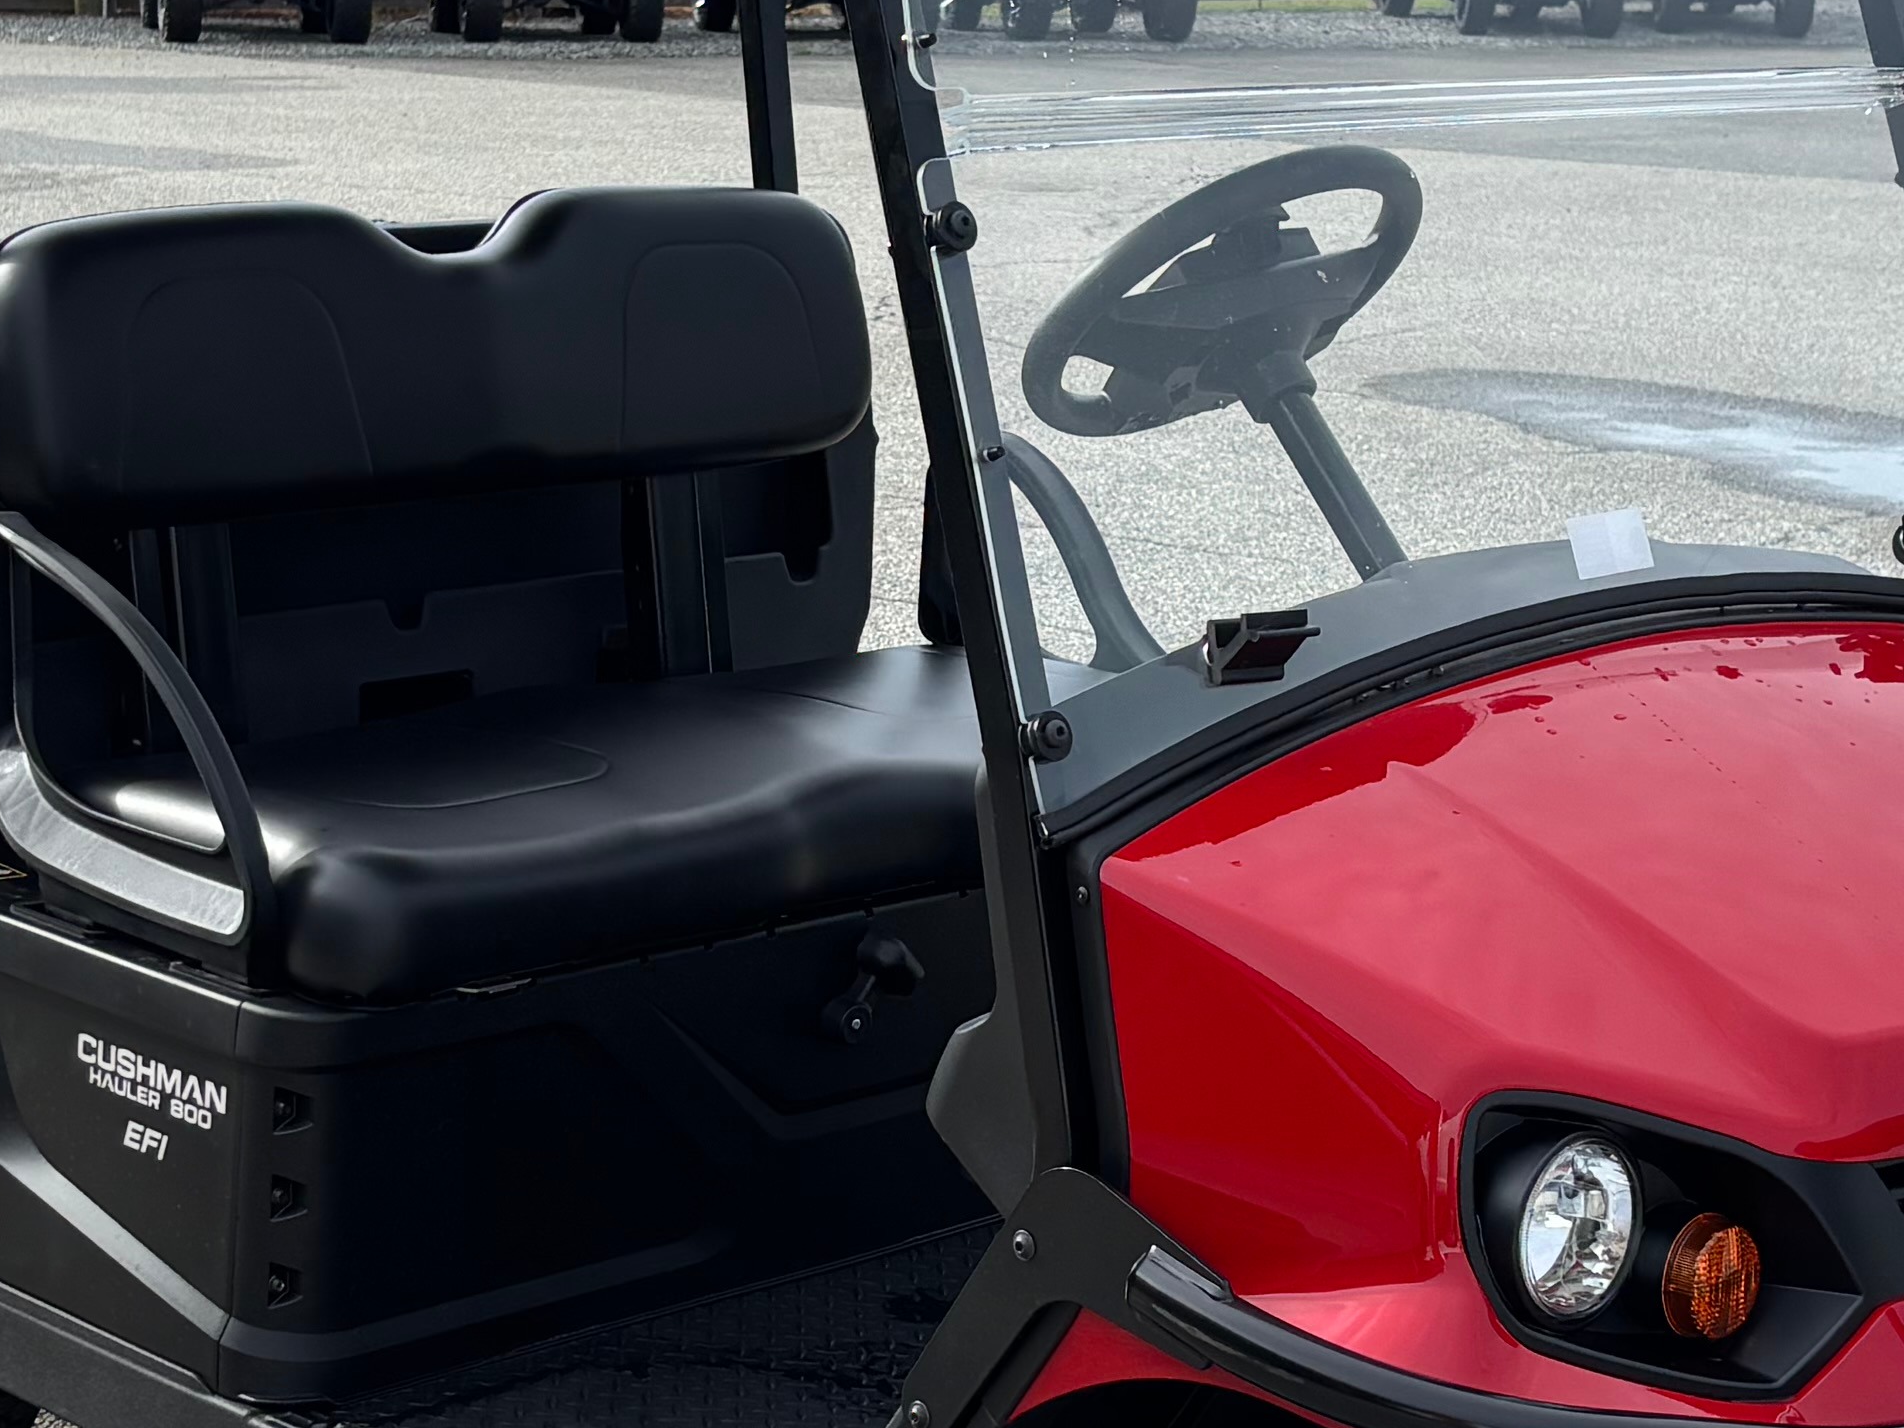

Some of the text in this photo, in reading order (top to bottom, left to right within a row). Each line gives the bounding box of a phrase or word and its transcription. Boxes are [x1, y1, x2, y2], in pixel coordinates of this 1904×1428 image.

[77, 1032, 227, 1114] CUSHMAN
[89, 1067, 212, 1130] HAULER 800
[123, 1120, 169, 1161] EFI
